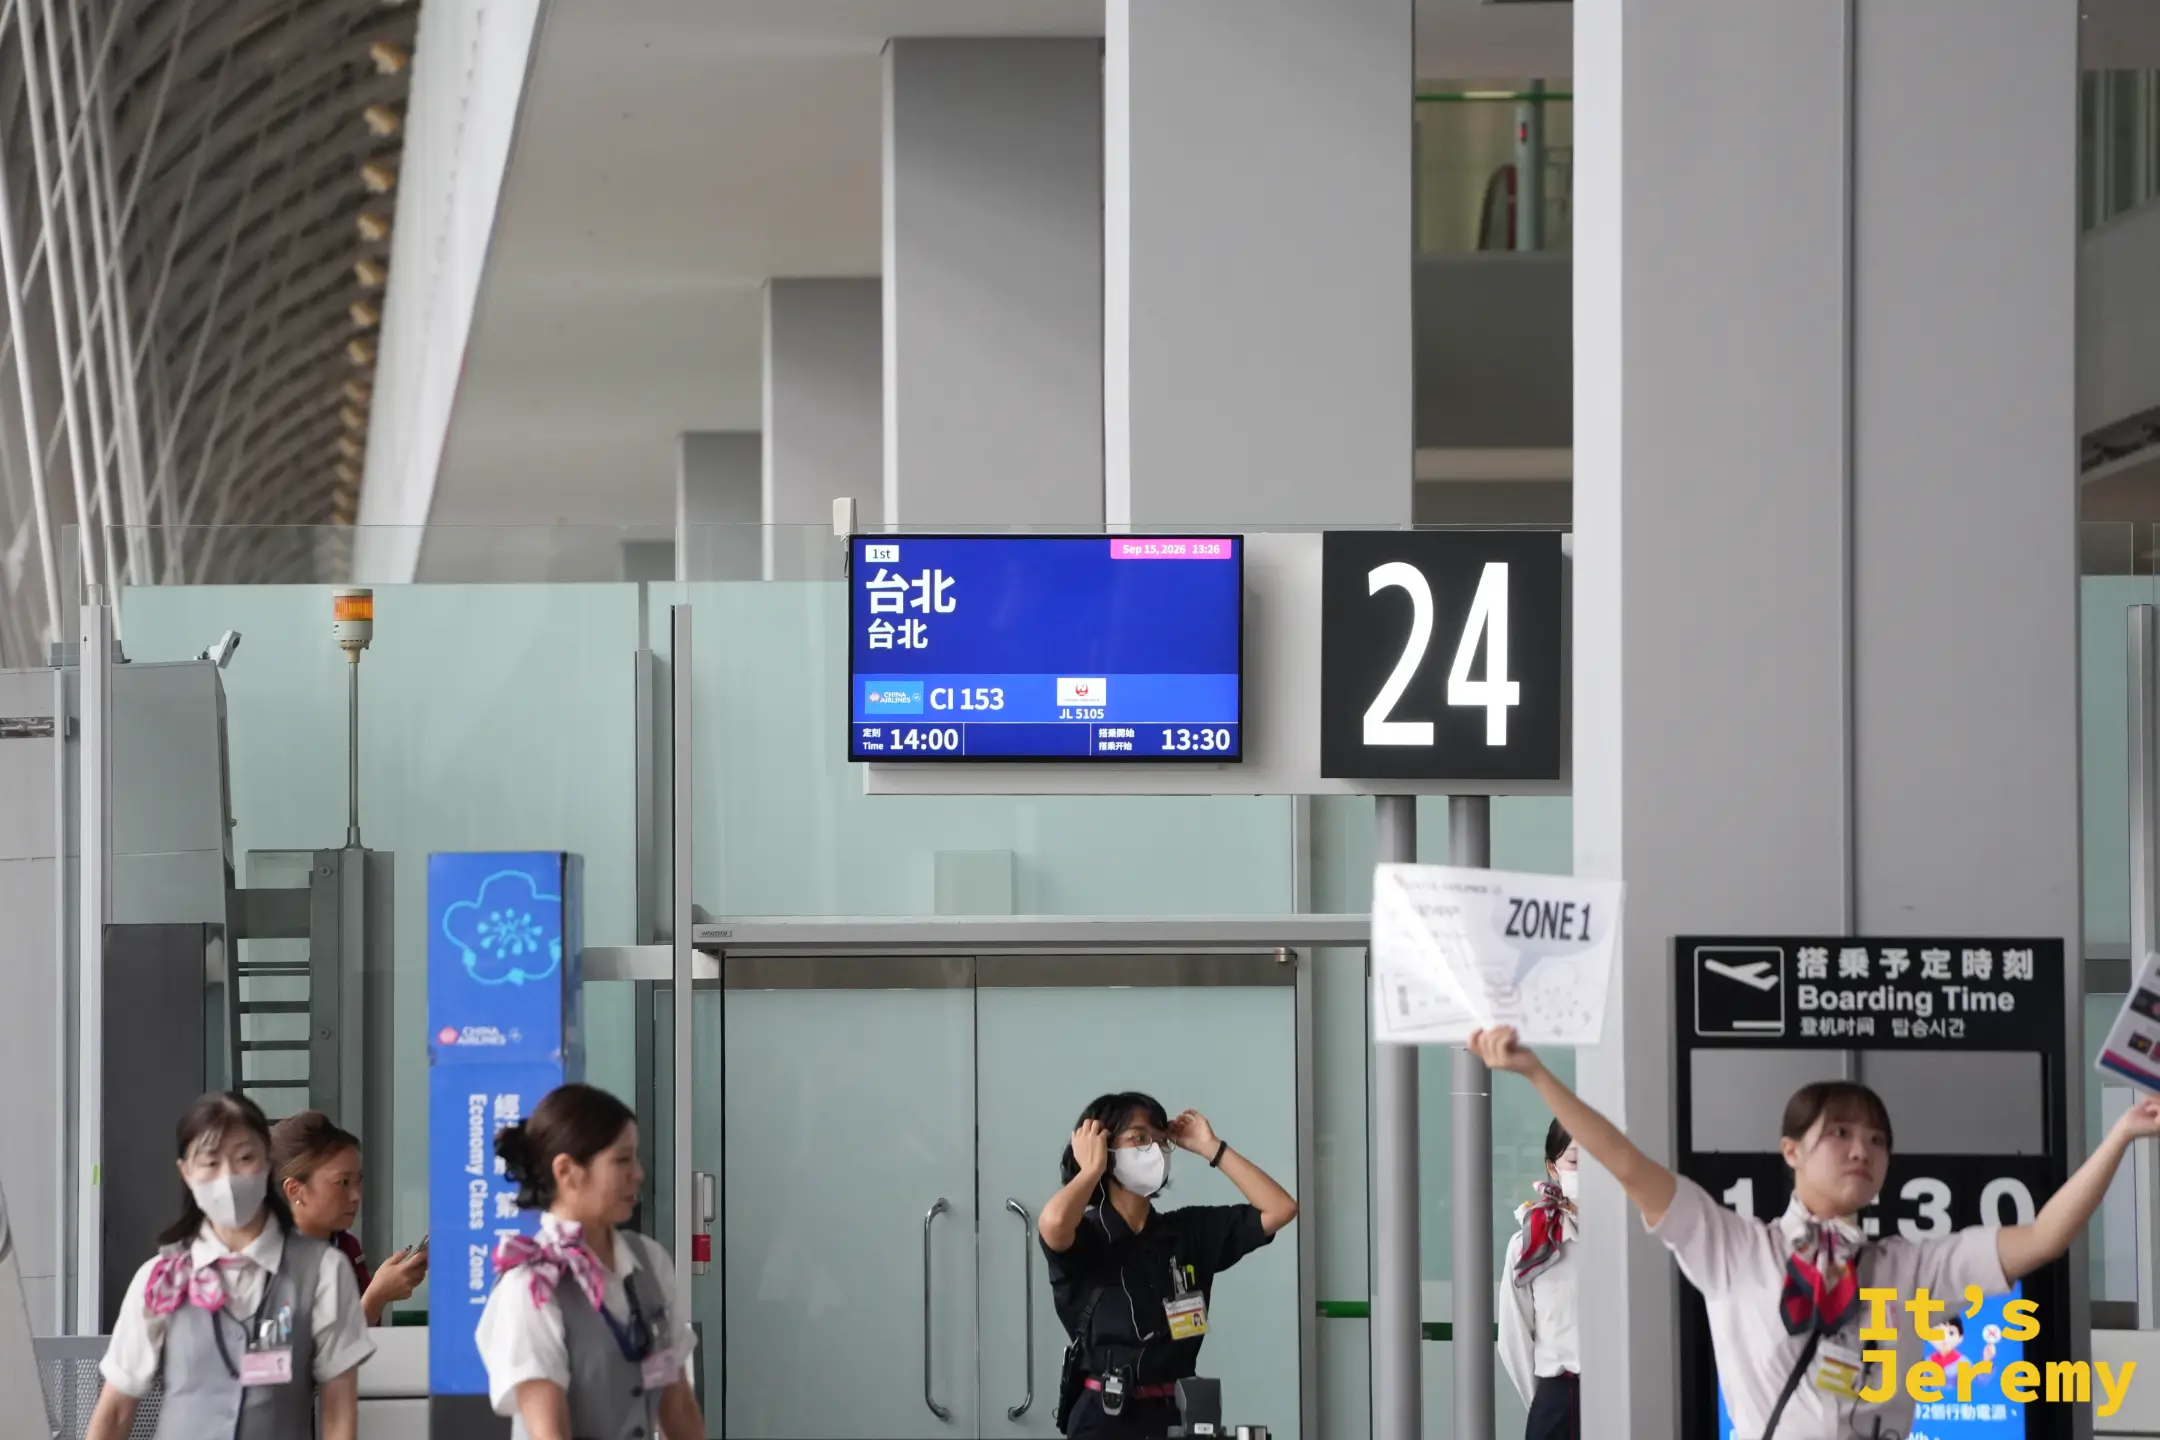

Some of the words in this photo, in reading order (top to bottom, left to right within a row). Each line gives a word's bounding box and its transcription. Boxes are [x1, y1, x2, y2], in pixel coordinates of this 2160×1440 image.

[872, 548, 891, 559] 1st
[1123, 544, 1142, 556] Sep
[1144, 544, 1160, 555] 15,
[1162, 544, 1186, 554] 2026
[1192, 544, 1220, 554] 13:26
[866, 568, 956, 614] 台北
[868, 618, 928, 649] 台北
[1363, 561, 1520, 746] 24
[930, 688, 955, 711] CI
[960, 688, 1004, 711] 153
[1059, 708, 1073, 719] JL
[1075, 708, 1105, 719] 5105
[862, 728, 881, 738] 定刻
[862, 741, 884, 750] Time
[890, 728, 959, 750] 14:00
[1161, 728, 1231, 751] 13:30
[1797, 947, 2034, 981] 搭乗予定時刻
[1798, 984, 1933, 1017] Boarding
[1941, 985, 2015, 1012] Time
[464, 1093, 488, 1176] Economy
[468, 1178, 488, 1230] Class
[468, 1243, 488, 1290] Zone
